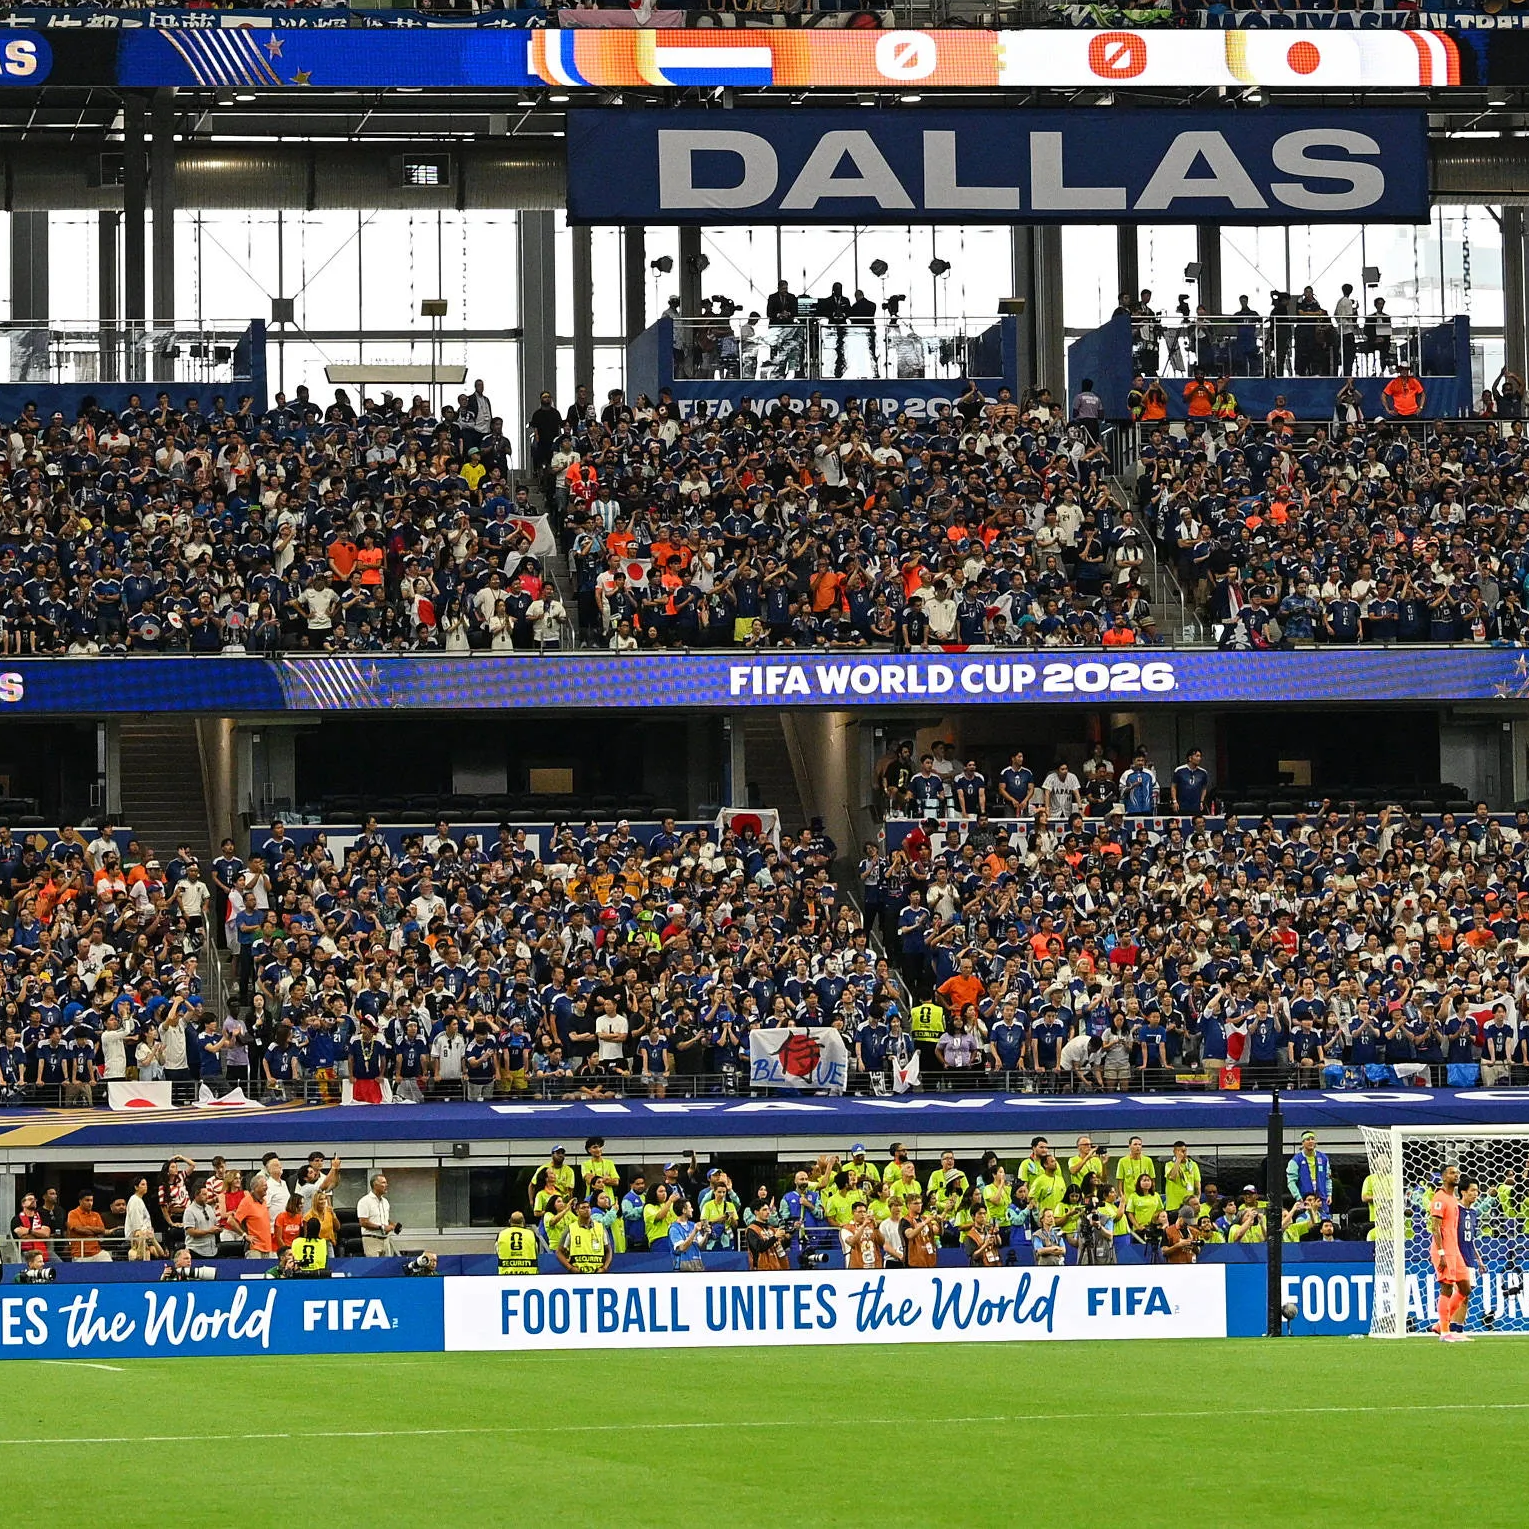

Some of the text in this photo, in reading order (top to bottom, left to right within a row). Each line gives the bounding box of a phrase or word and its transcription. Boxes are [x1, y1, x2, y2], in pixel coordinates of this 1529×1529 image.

[657, 128, 1386, 211] DALLAS
[729, 661, 1174, 696] FIFA WORLD CUP 2026
[489, 1101, 840, 1115] FIFA
[851, 1092, 1435, 1109] WORLD
[59, 1289, 136, 1346] the
[144, 1285, 278, 1349] World
[304, 1299, 390, 1332] FIFA
[501, 1273, 1171, 1335] FOOTBALL UNITES the World FIFA
